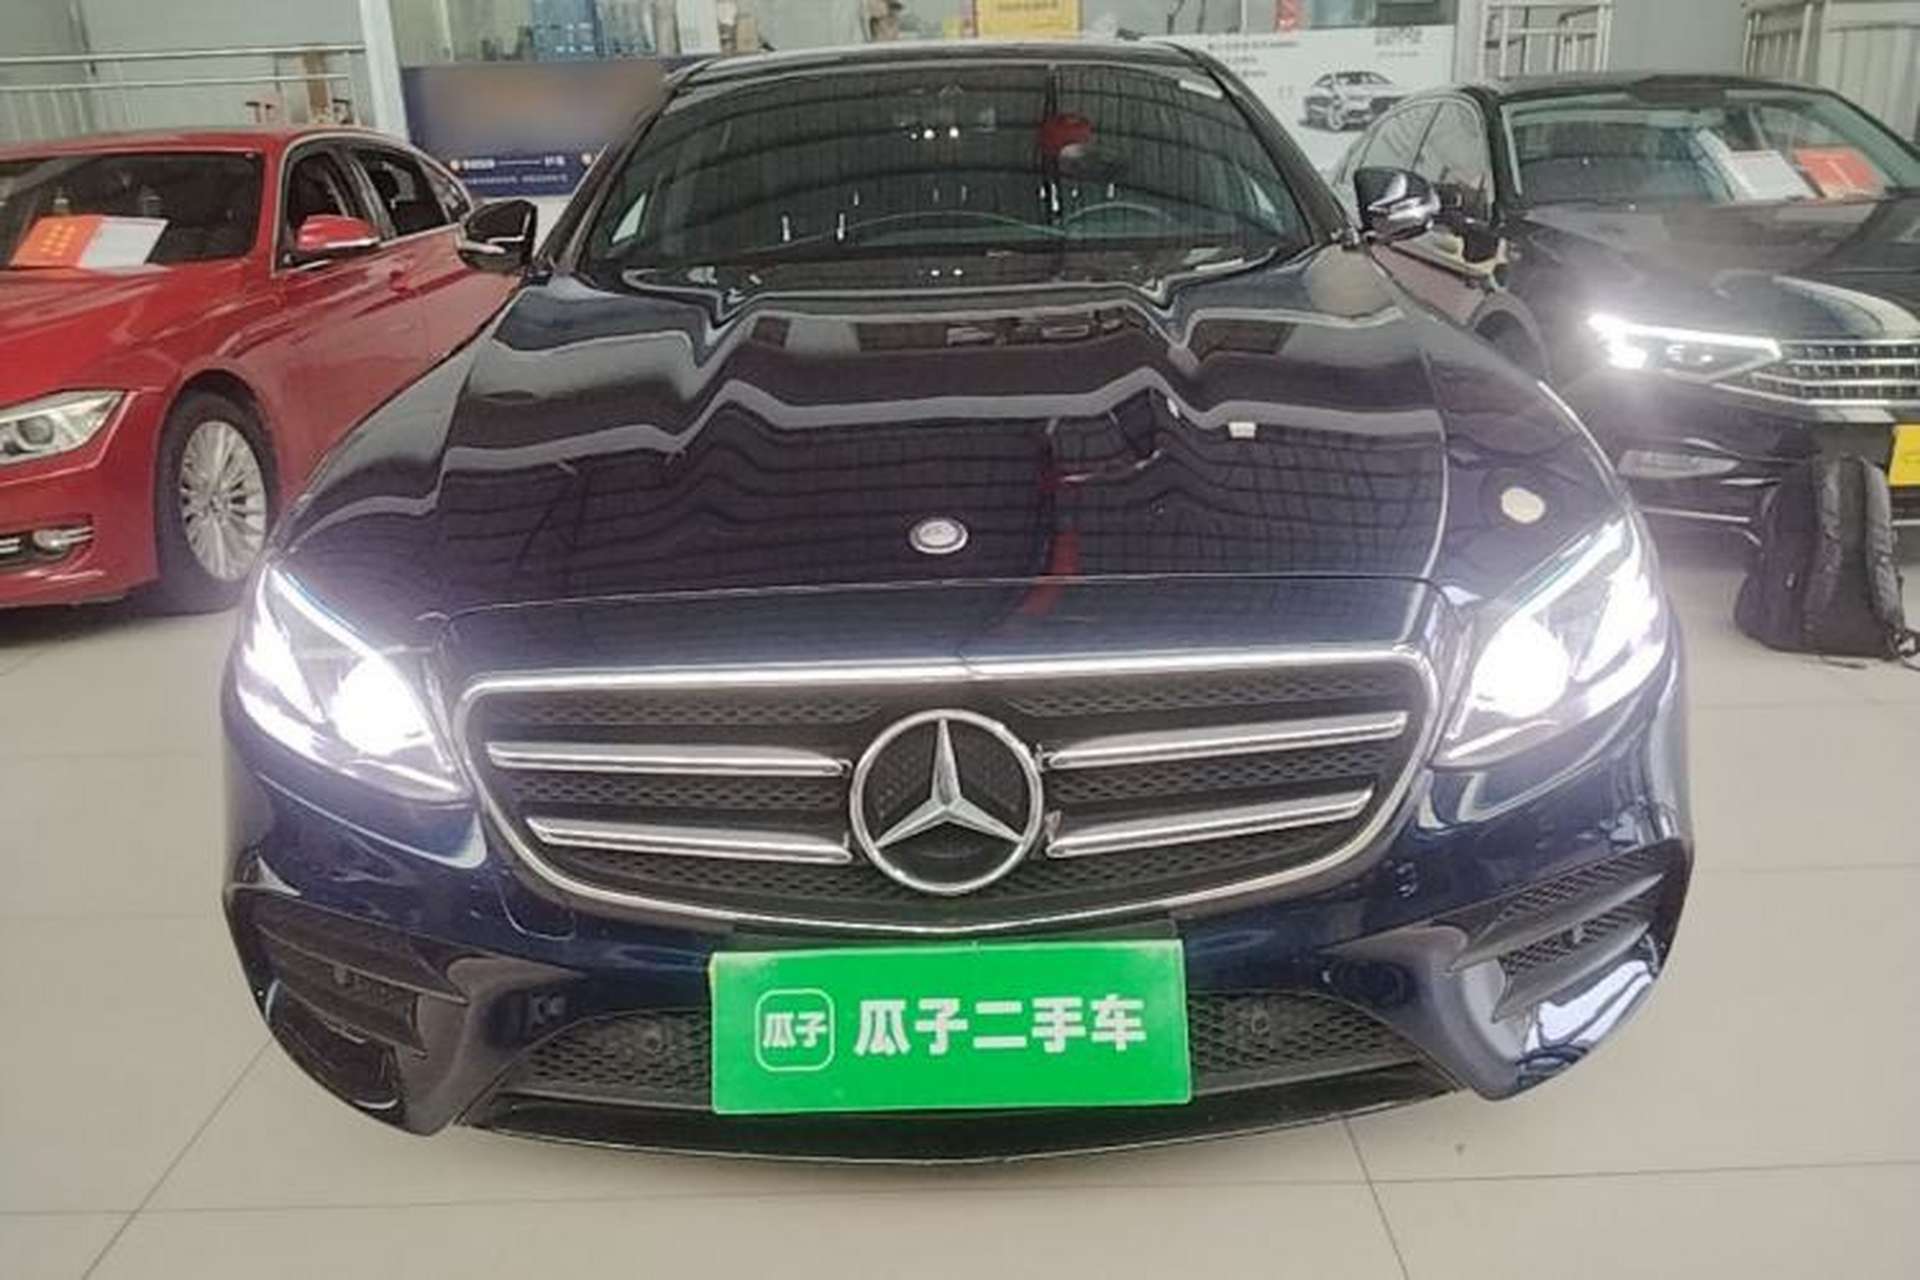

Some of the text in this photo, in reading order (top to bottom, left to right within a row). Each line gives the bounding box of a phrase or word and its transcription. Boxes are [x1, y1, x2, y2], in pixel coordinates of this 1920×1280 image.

[762, 1011, 828, 1049] 瓜子
[853, 993, 1148, 1056] 瓜子二手车
